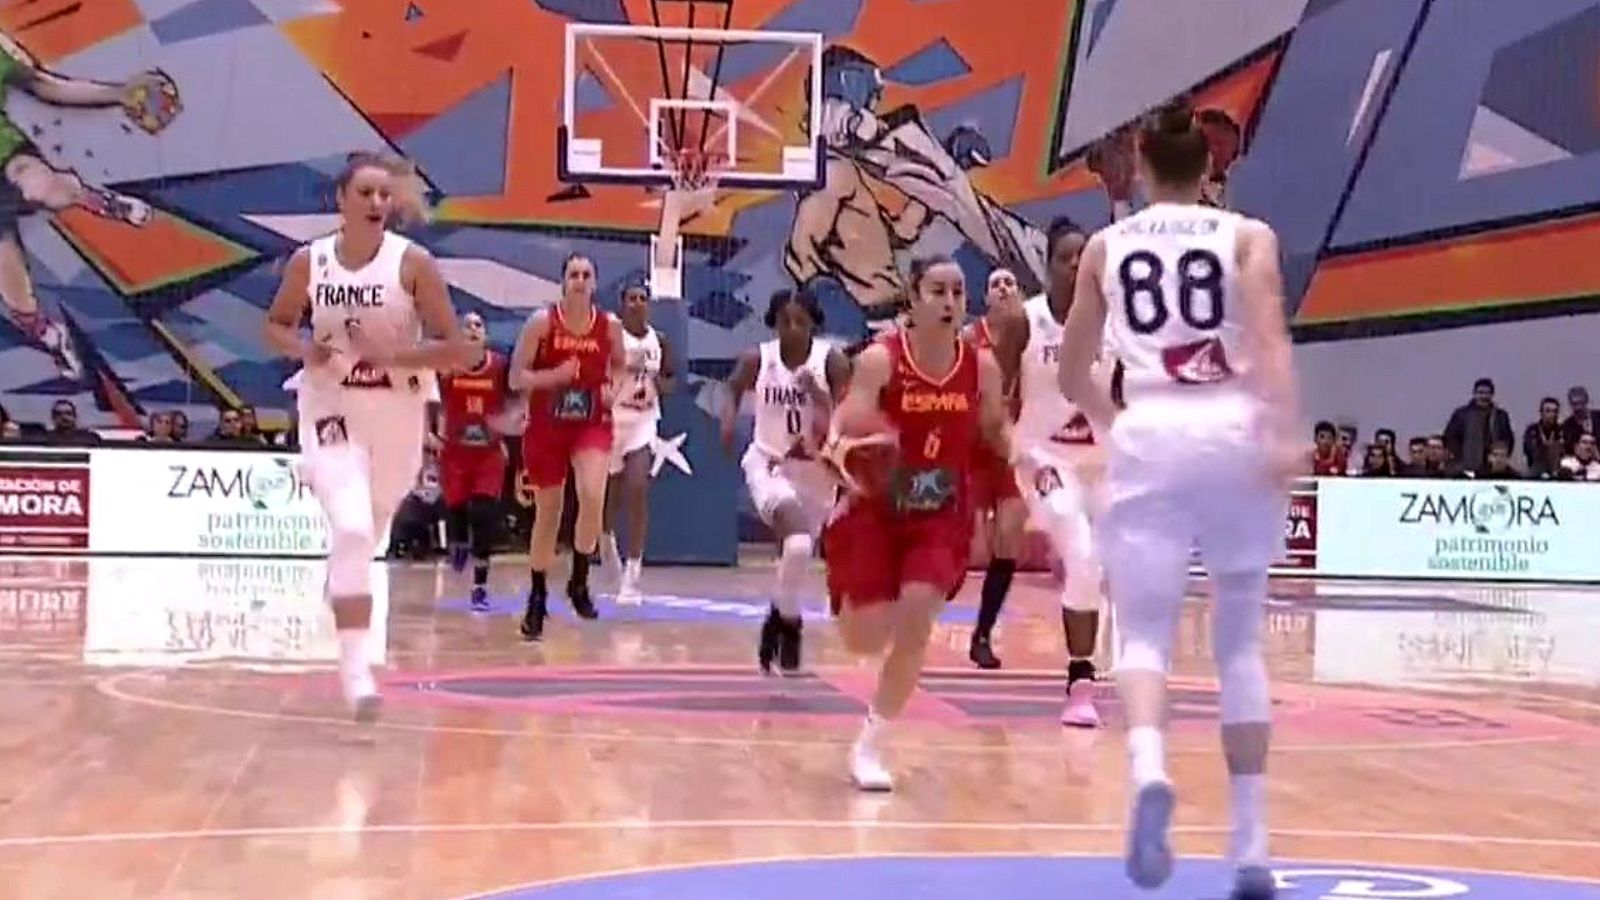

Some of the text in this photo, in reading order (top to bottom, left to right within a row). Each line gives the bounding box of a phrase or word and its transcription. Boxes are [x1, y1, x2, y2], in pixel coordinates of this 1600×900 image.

[316, 283, 384, 307] FRANCE
[1118, 248, 1224, 335] 88
[787, 409, 802, 435] 0
[57, 479, 82, 494] DE
[0, 493, 84, 516] MORA
[1435, 536, 1549, 556] patrimonio
[1428, 555, 1530, 573] sostenible
